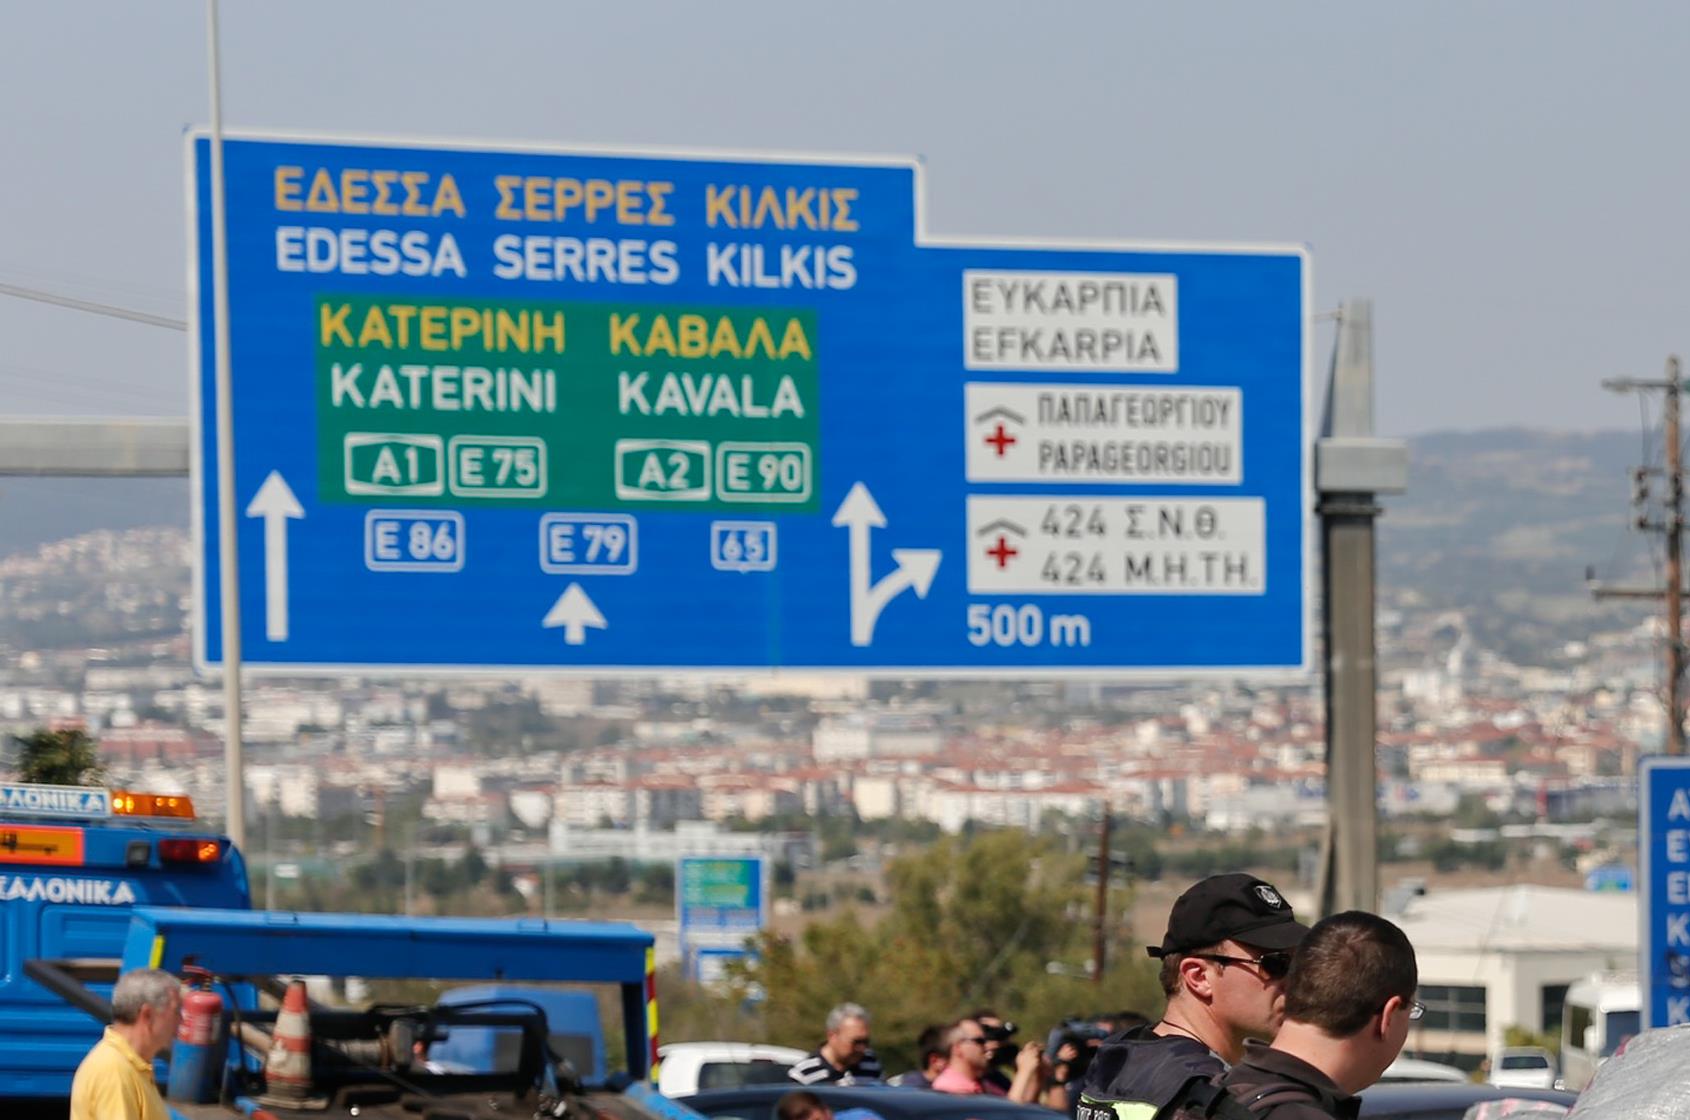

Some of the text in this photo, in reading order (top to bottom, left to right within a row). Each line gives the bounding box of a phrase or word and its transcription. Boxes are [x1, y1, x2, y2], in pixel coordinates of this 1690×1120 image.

[275, 166, 858, 231] ΕΔΕΣΣΑ ΣΕΡΡΕΣ ΚΙΛΚΙΣ
[276, 227, 856, 289] EDESSA SERRES KILKIS
[972, 278, 1166, 317] ΕΥΚΑΡΠΙΑ
[321, 304, 811, 359] ΚΑΤΕΡΙΝΗ ΚΑΒΑΛΑ
[972, 327, 1162, 363] EFKARPIA
[332, 364, 804, 417] KATERINI KAVALA
[1037, 391, 1230, 428] ΠΑΠΑΓΕΩΡΓΙΟΥ
[372, 445, 422, 484] A1
[461, 446, 536, 485] E 75
[638, 452, 692, 491] A2
[728, 454, 801, 492] E 90
[1039, 441, 1230, 474] PAPAGEORGIOU
[374, 521, 455, 561] E 86
[1041, 504, 1107, 540] 424
[548, 524, 627, 564] E 79
[721, 532, 766, 564] 65
[1041, 551, 1107, 586] 424
[968, 604, 1090, 646] 500 m
